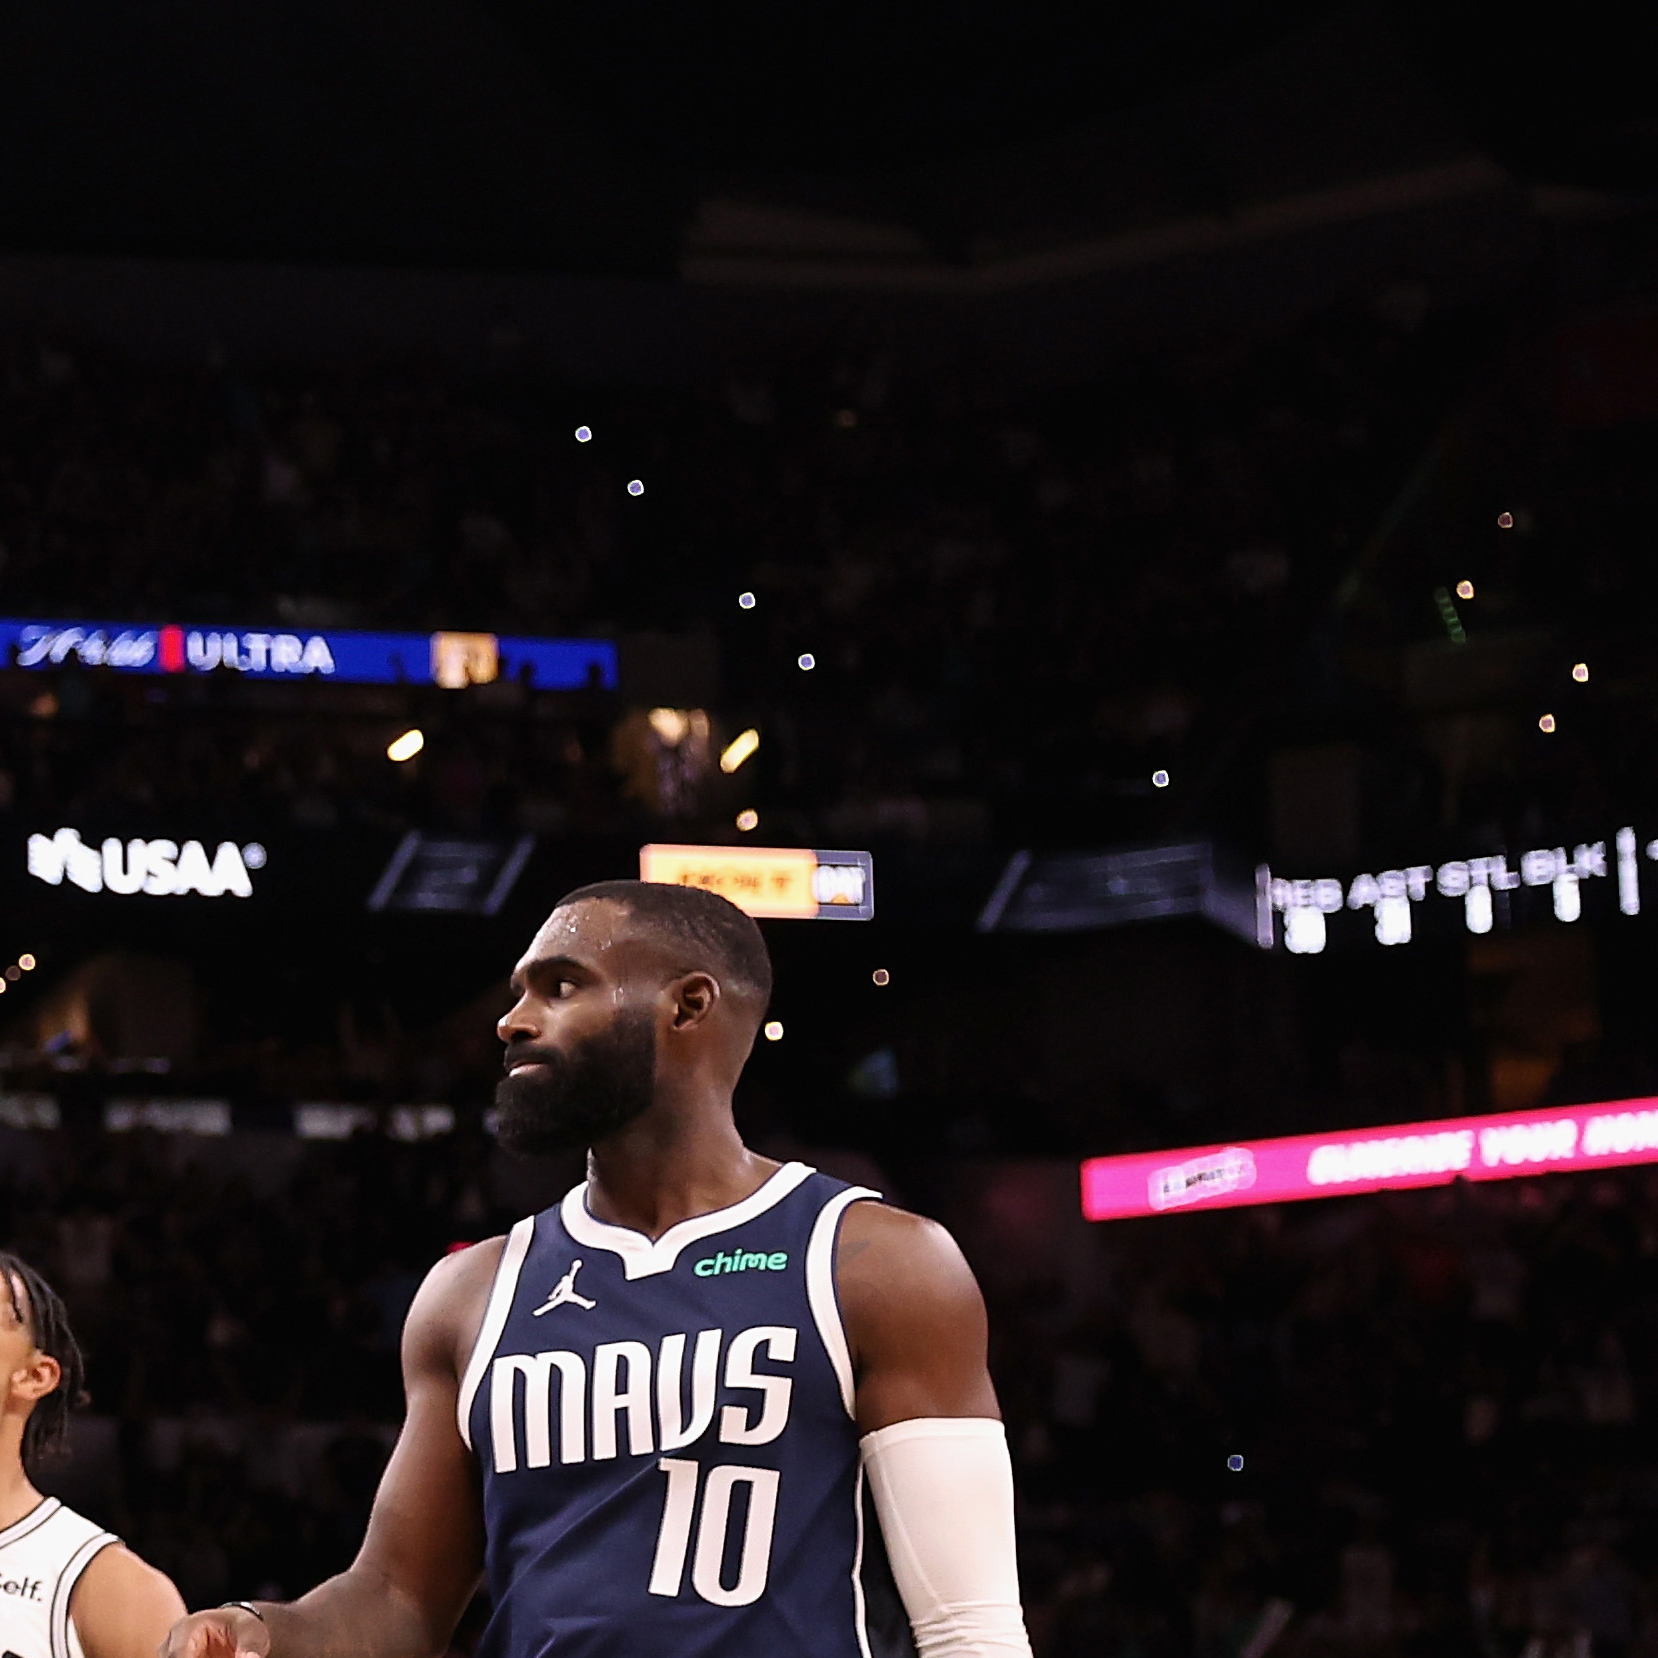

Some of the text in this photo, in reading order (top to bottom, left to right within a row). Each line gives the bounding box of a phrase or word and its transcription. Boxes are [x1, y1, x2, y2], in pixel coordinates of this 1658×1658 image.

[187, 631, 336, 675] ULTRA
[102, 837, 254, 898] USAA
[694, 1248, 789, 1278] chime
[489, 1325, 799, 1475] MAVS
[647, 1456, 782, 1608] 10
